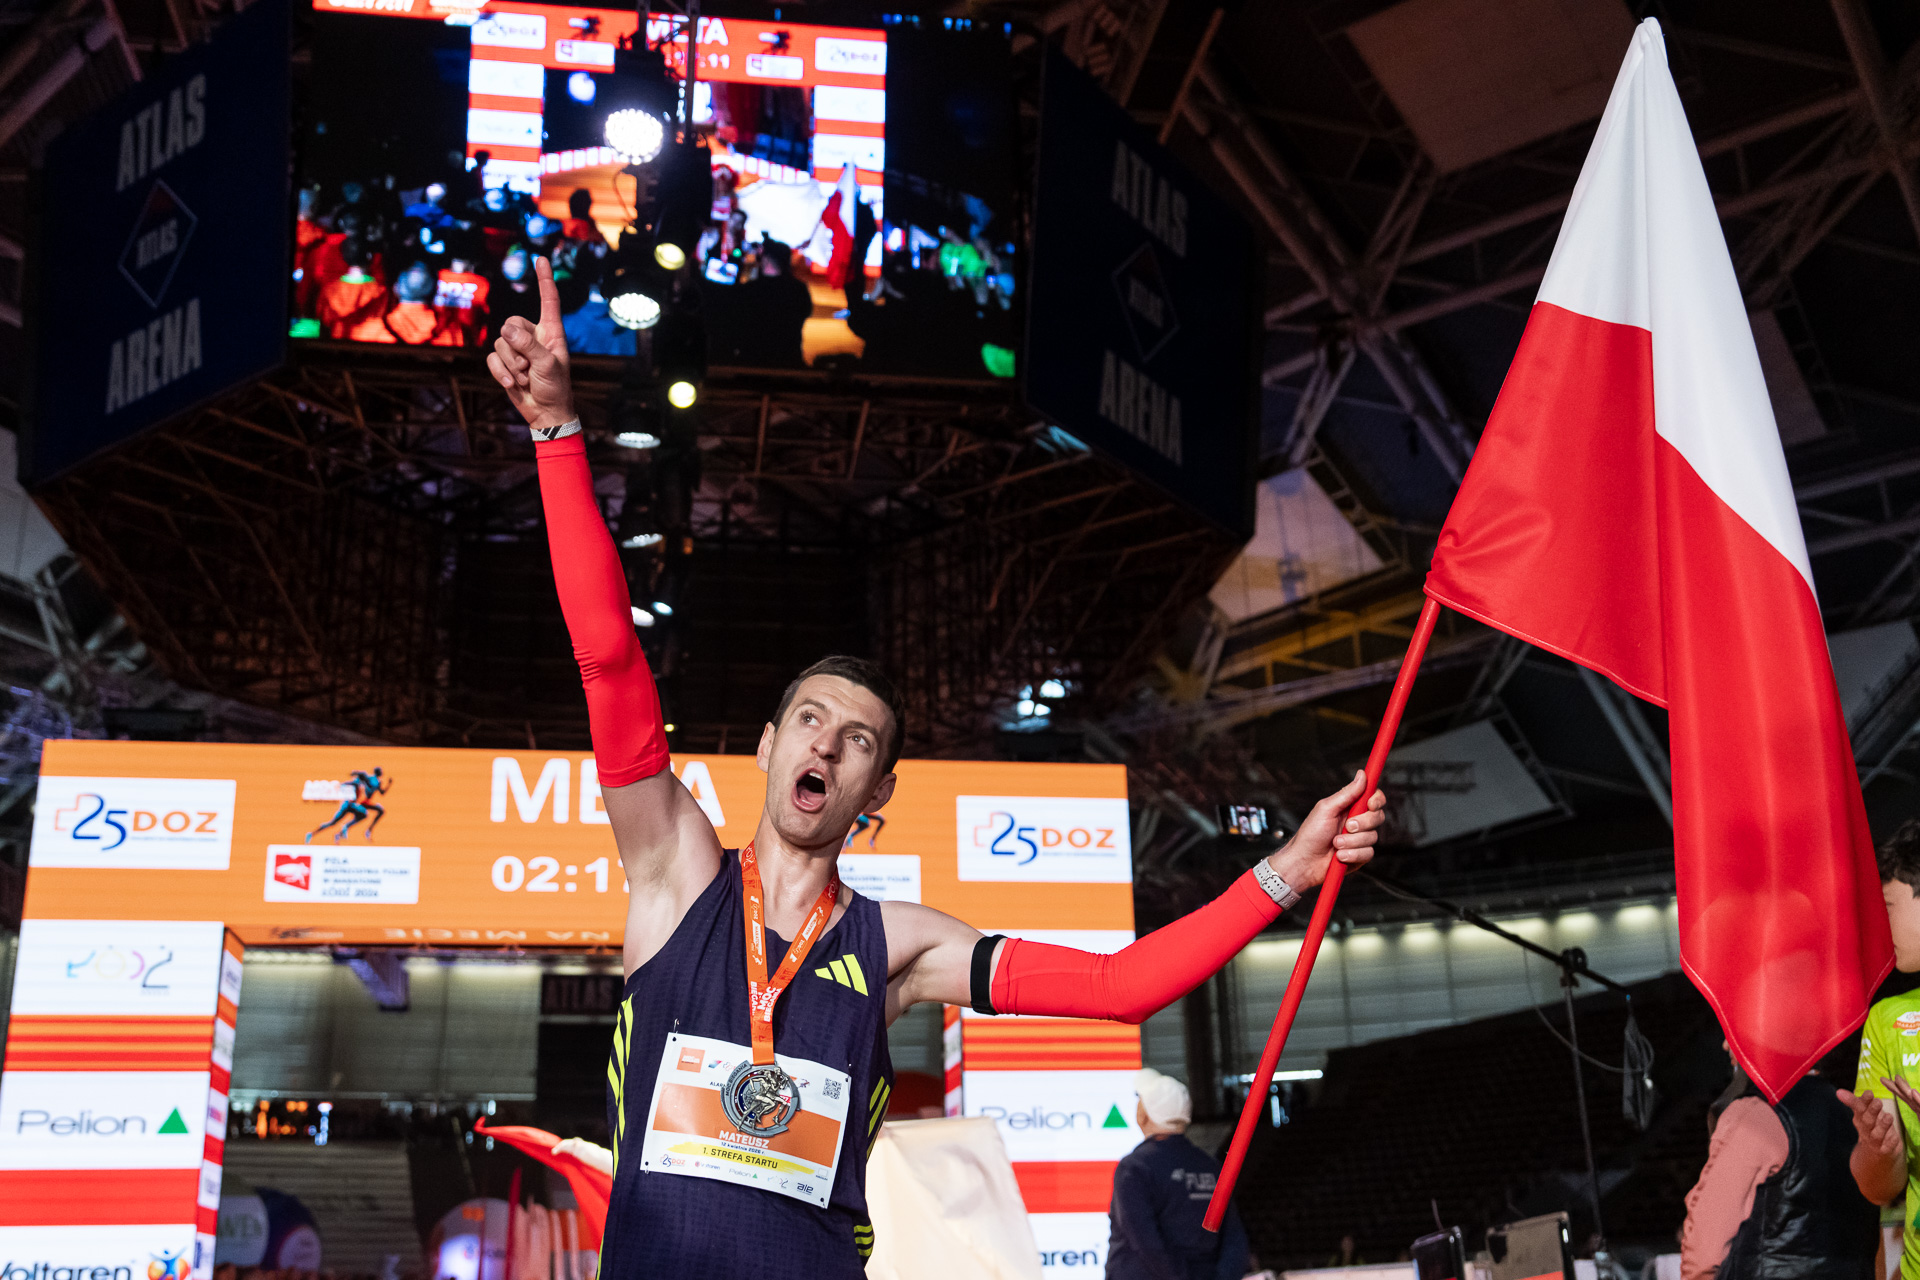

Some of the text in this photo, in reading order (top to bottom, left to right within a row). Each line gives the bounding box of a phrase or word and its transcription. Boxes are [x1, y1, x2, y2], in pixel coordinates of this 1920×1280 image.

[116, 73, 206, 191] ATLAS
[1111, 140, 1188, 258] ATLAS
[106, 298, 201, 414] ARENA
[1099, 349, 1183, 466] ARENA
[72, 793, 218, 851] 25 DOZ
[991, 812, 1115, 866] 25 DOZ
[491, 855, 629, 893] 02:1
[17, 1109, 147, 1135] Pelion
[719, 1130, 770, 1149] MATEUSZ
[981, 1106, 1092, 1130] Pelion
[703, 1147, 778, 1169] 1. STREFA STARTU
